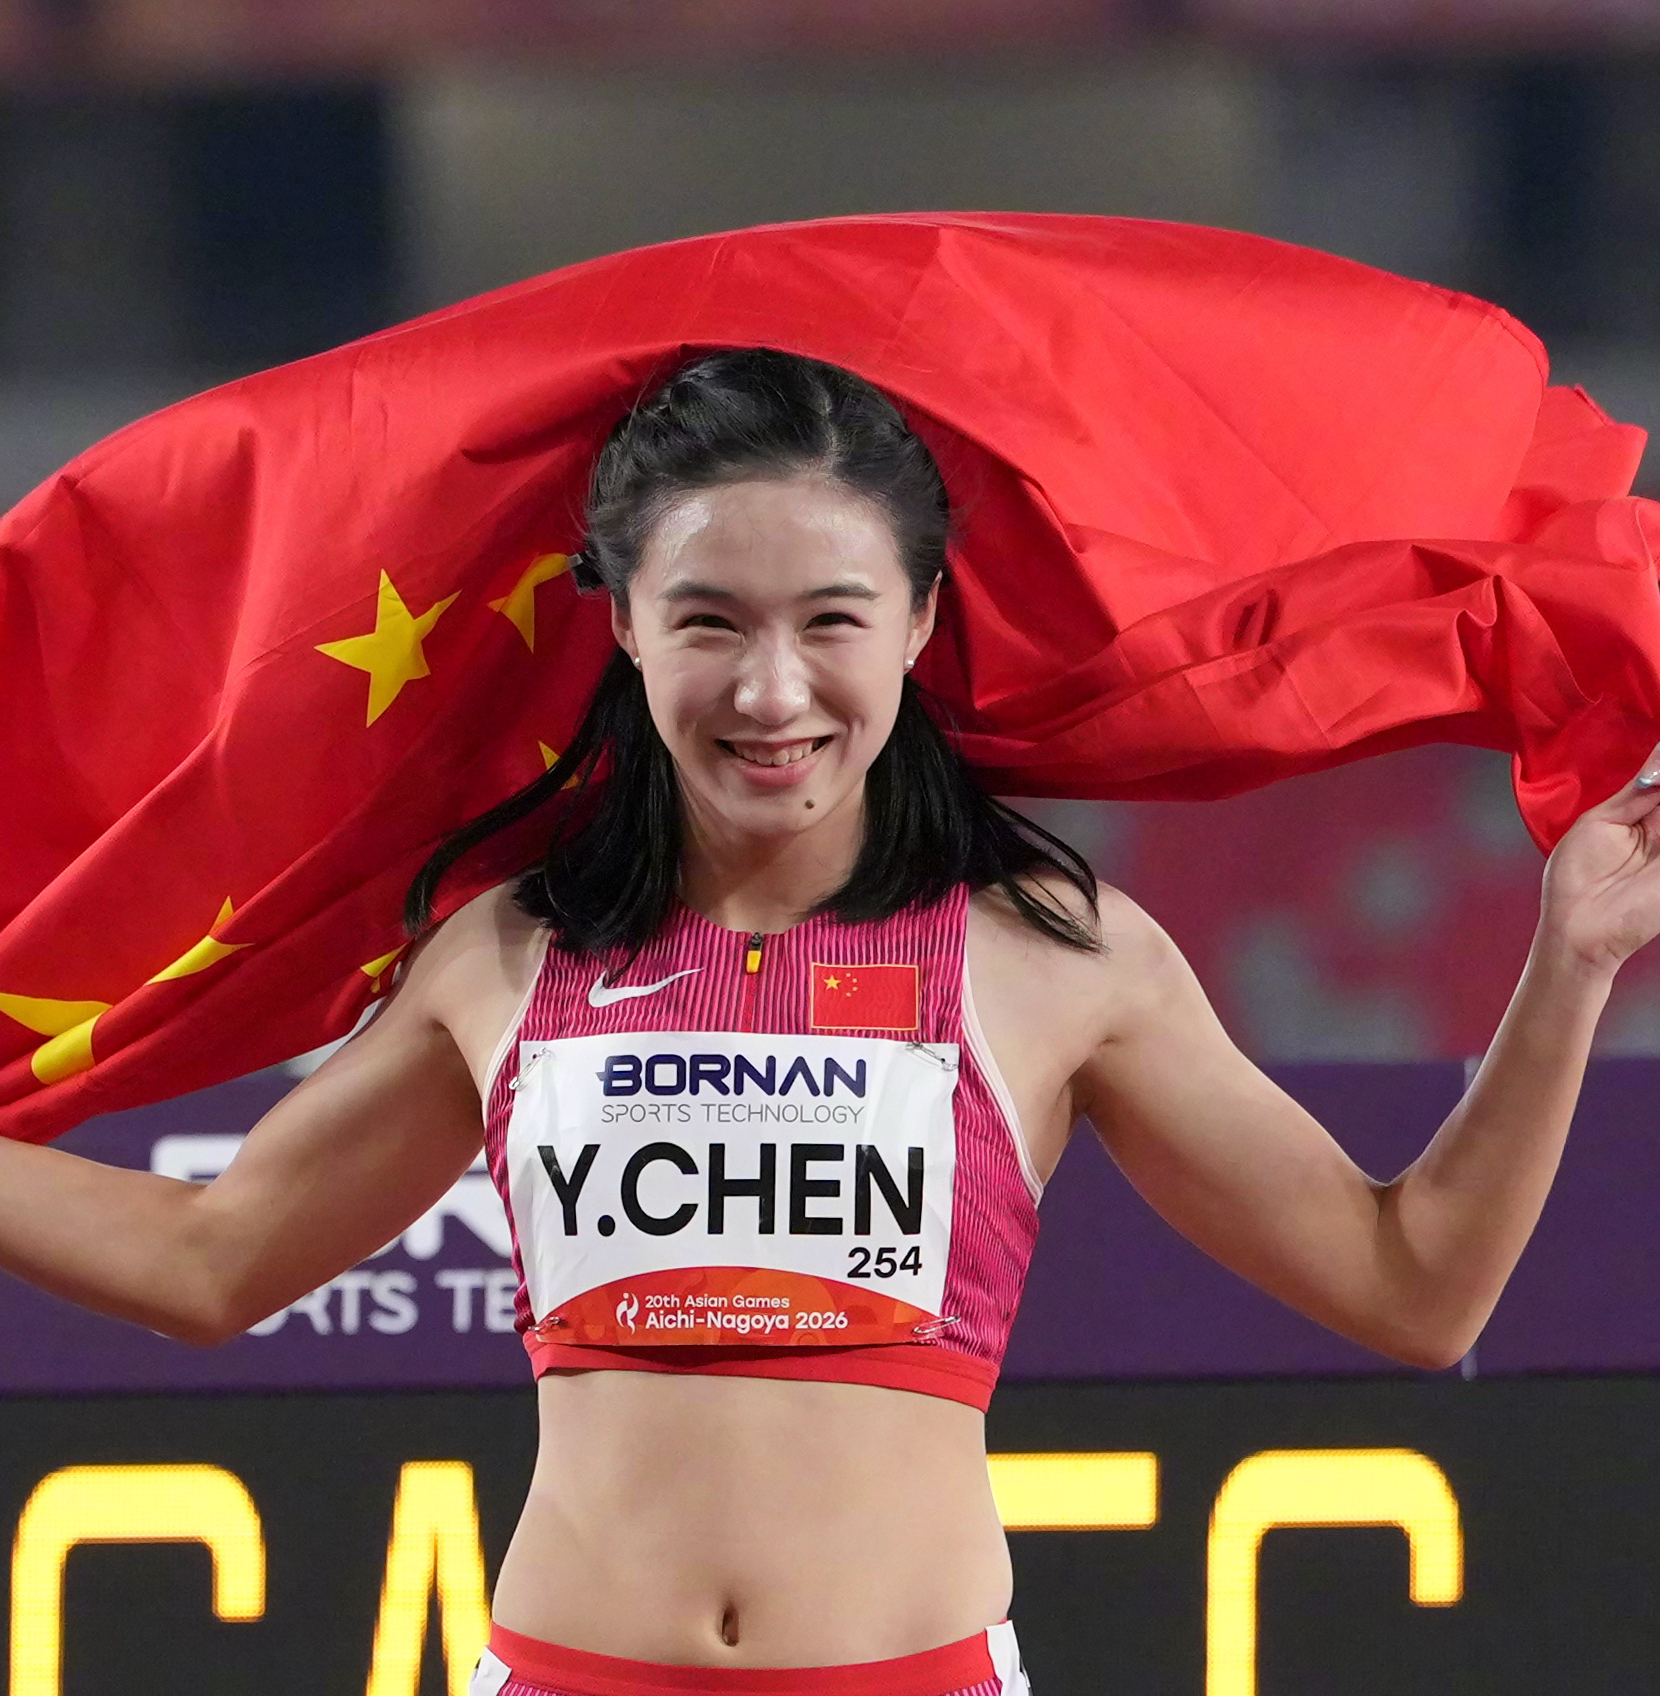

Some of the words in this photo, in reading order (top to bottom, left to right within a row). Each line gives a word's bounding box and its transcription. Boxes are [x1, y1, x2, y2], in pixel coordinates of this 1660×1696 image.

[596, 1054, 867, 1099] BORNAN
[601, 1103, 692, 1125] SPORTS
[700, 1103, 865, 1125] TECHNOLOGY
[538, 1142, 925, 1238] Y.CHEN
[847, 1246, 924, 1280] 254
[645, 1295, 680, 1309] 20th
[684, 1294, 728, 1309] Asian
[732, 1294, 790, 1310] Games
[645, 1310, 790, 1335] Aichi-Nagoya
[795, 1311, 849, 1330] 2026
